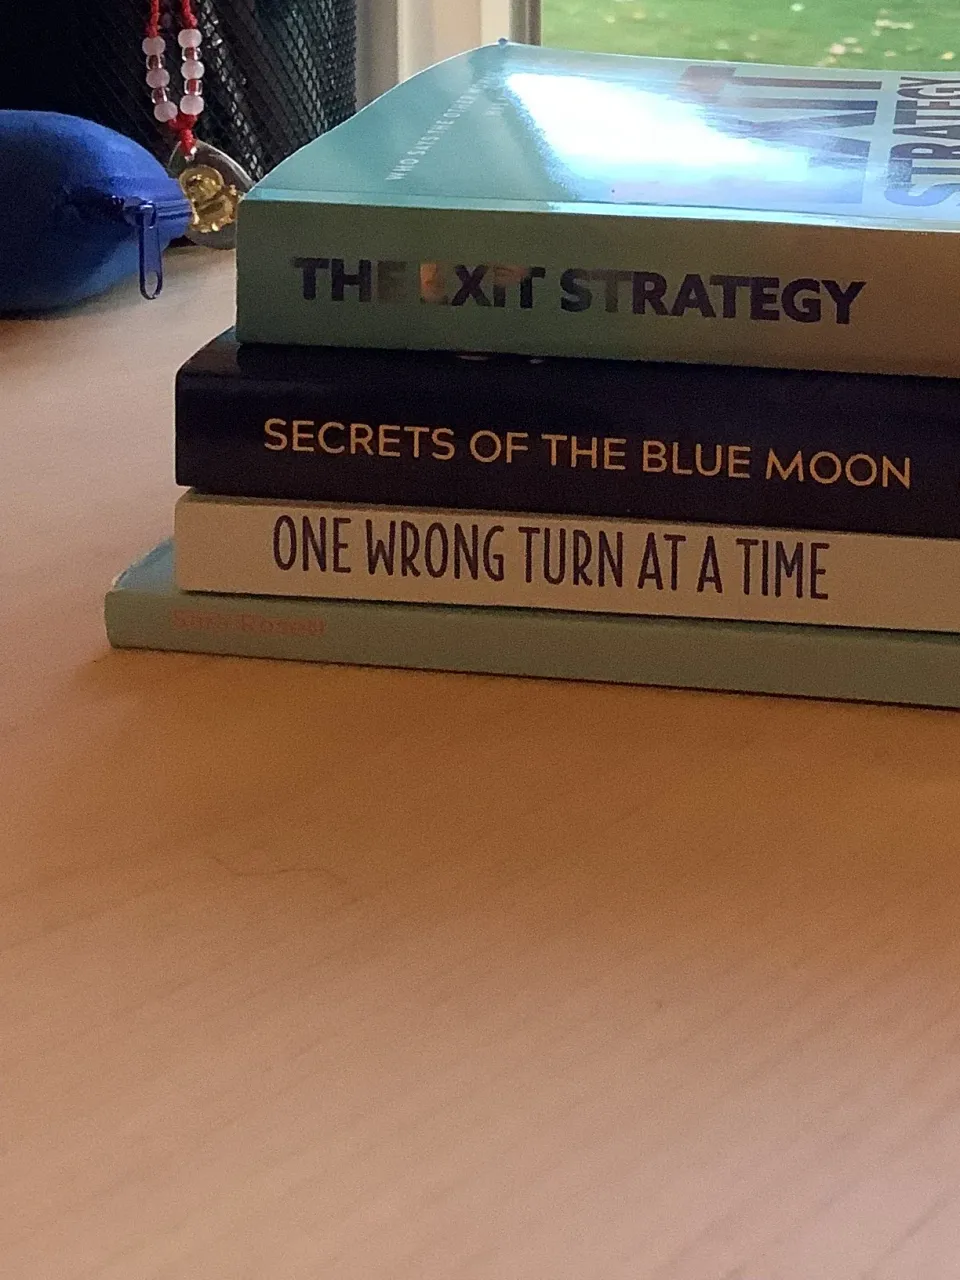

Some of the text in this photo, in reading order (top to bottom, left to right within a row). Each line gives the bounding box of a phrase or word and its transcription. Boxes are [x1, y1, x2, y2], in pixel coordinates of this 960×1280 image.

[295, 256, 408, 305] THE
[559, 268, 867, 325] STRATEGY
[263, 418, 911, 490] SECRETS OF THE BLUE MOON
[273, 514, 830, 600] ONE WRONG TURN AT A TIME
